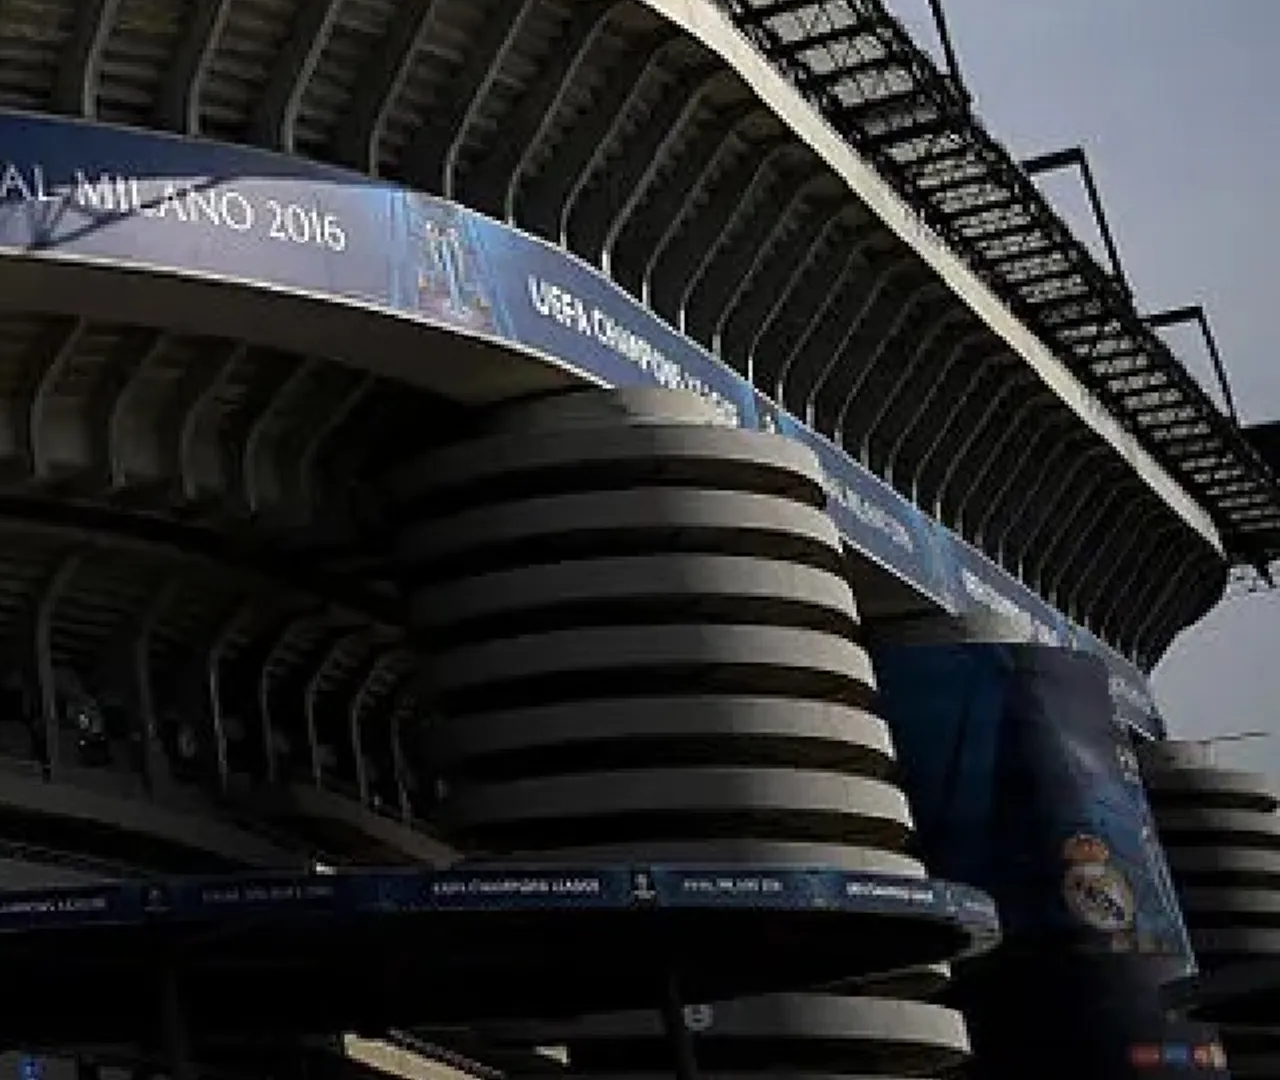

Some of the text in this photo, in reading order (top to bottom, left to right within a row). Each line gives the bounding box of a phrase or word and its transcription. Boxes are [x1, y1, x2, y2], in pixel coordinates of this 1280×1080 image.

[75, 168, 252, 231] MILANO
[267, 198, 346, 252] 2016
[528, 273, 591, 337] UEFA
